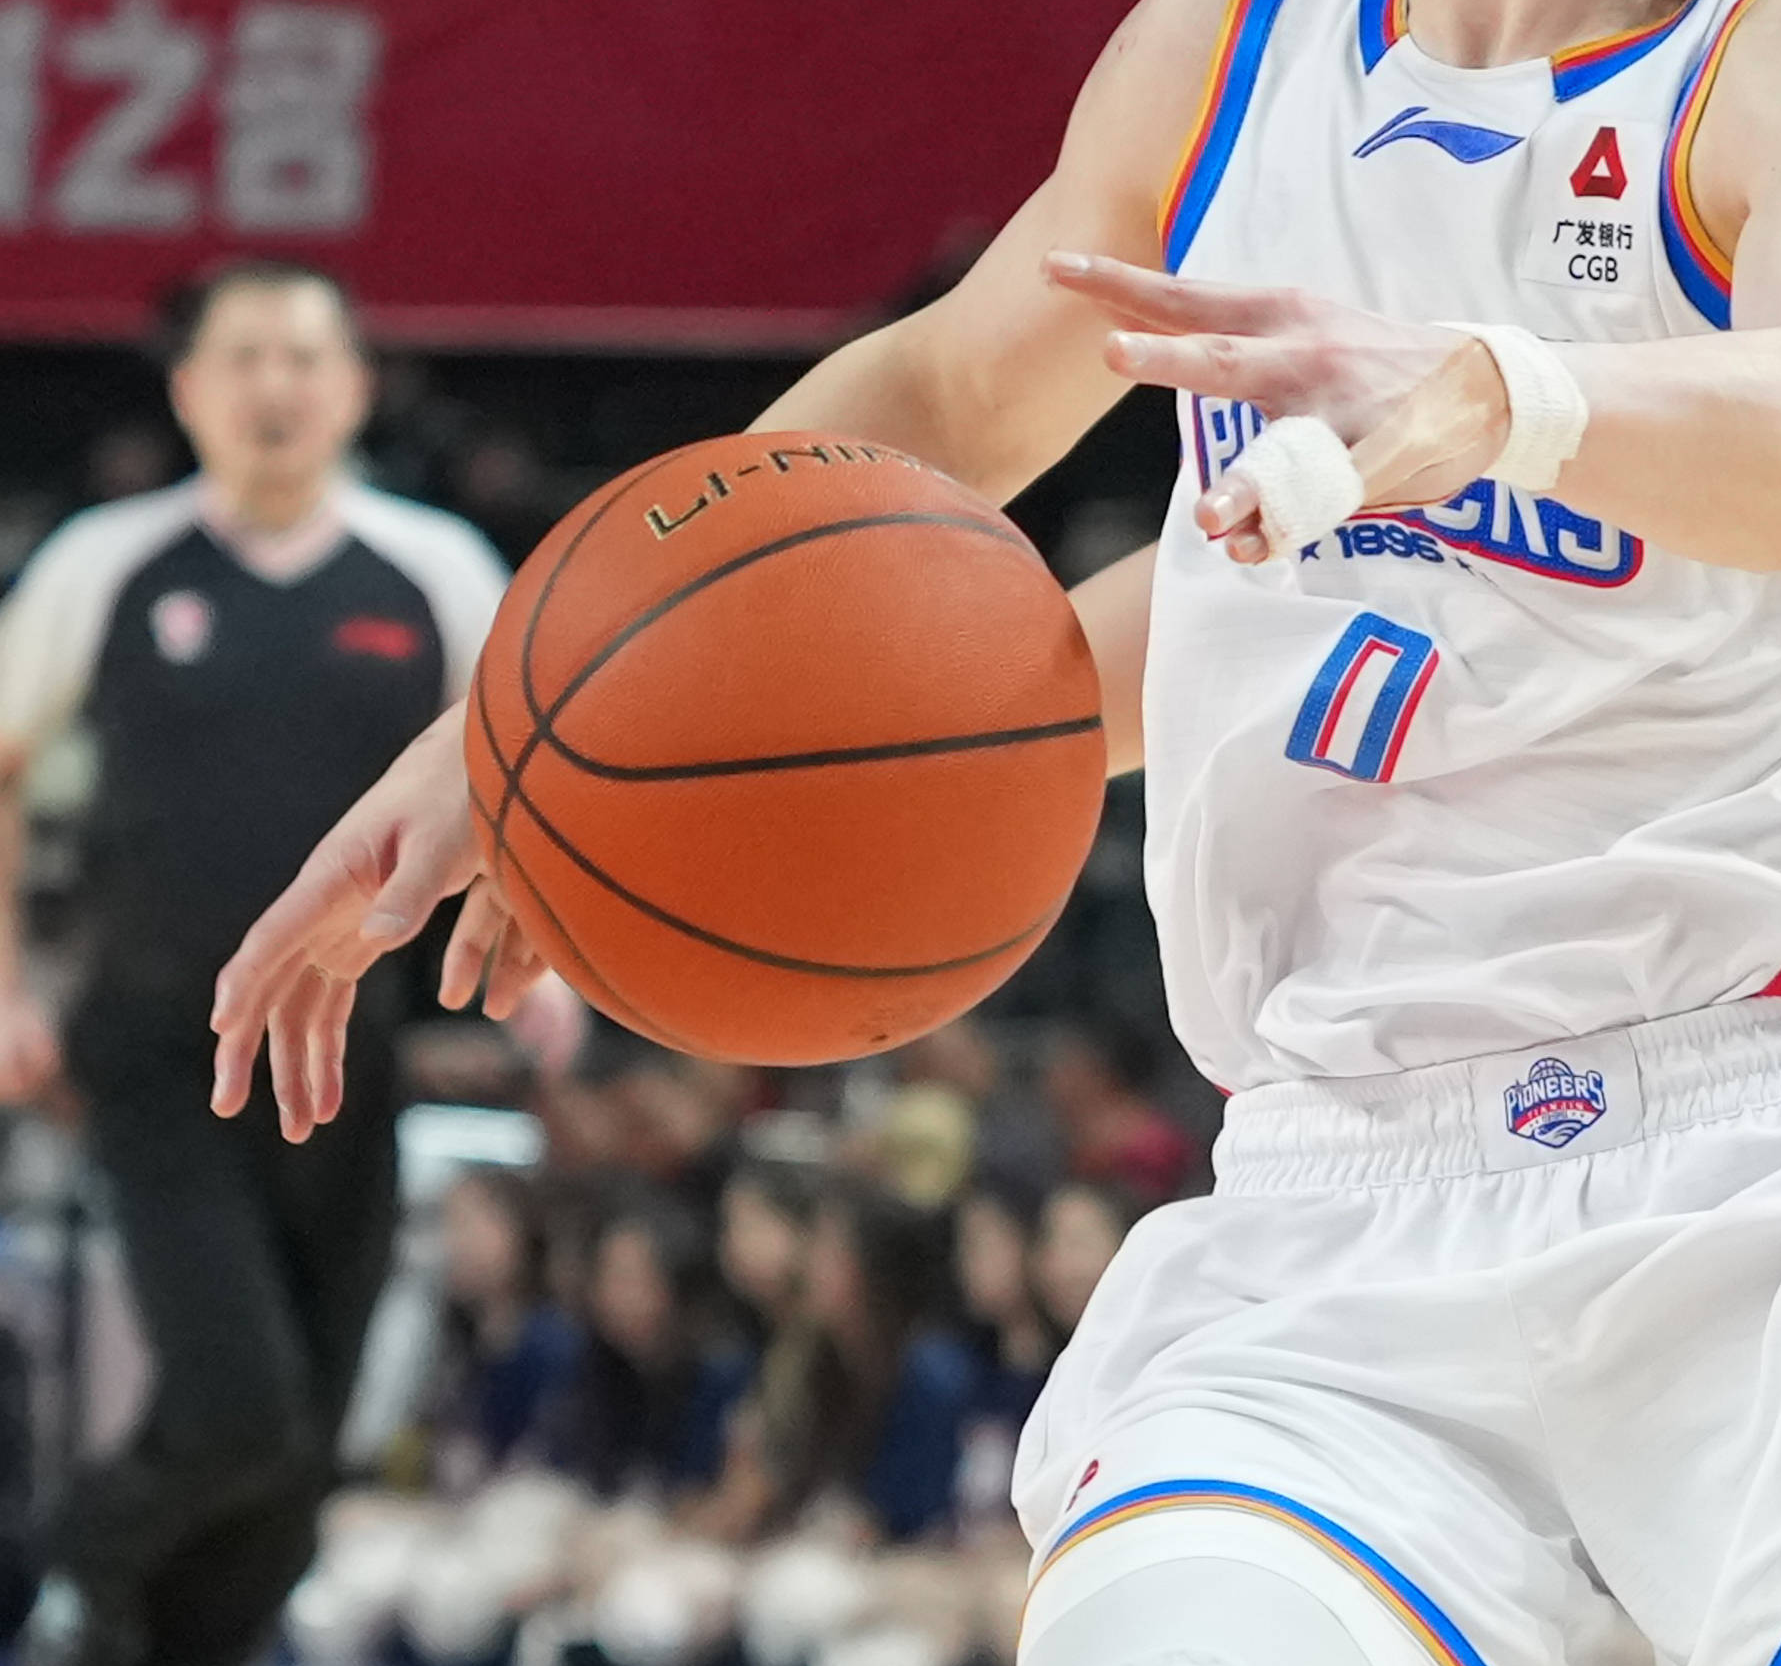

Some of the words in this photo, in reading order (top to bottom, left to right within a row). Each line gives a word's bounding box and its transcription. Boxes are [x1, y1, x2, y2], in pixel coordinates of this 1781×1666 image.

[1552, 219, 1634, 251] 广发银行
[1568, 254, 1619, 283] CGB
[1334, 522, 1446, 563] 1896
[1284, 610, 1440, 784] 0
[1505, 1071, 1606, 1132] PIONEERS
